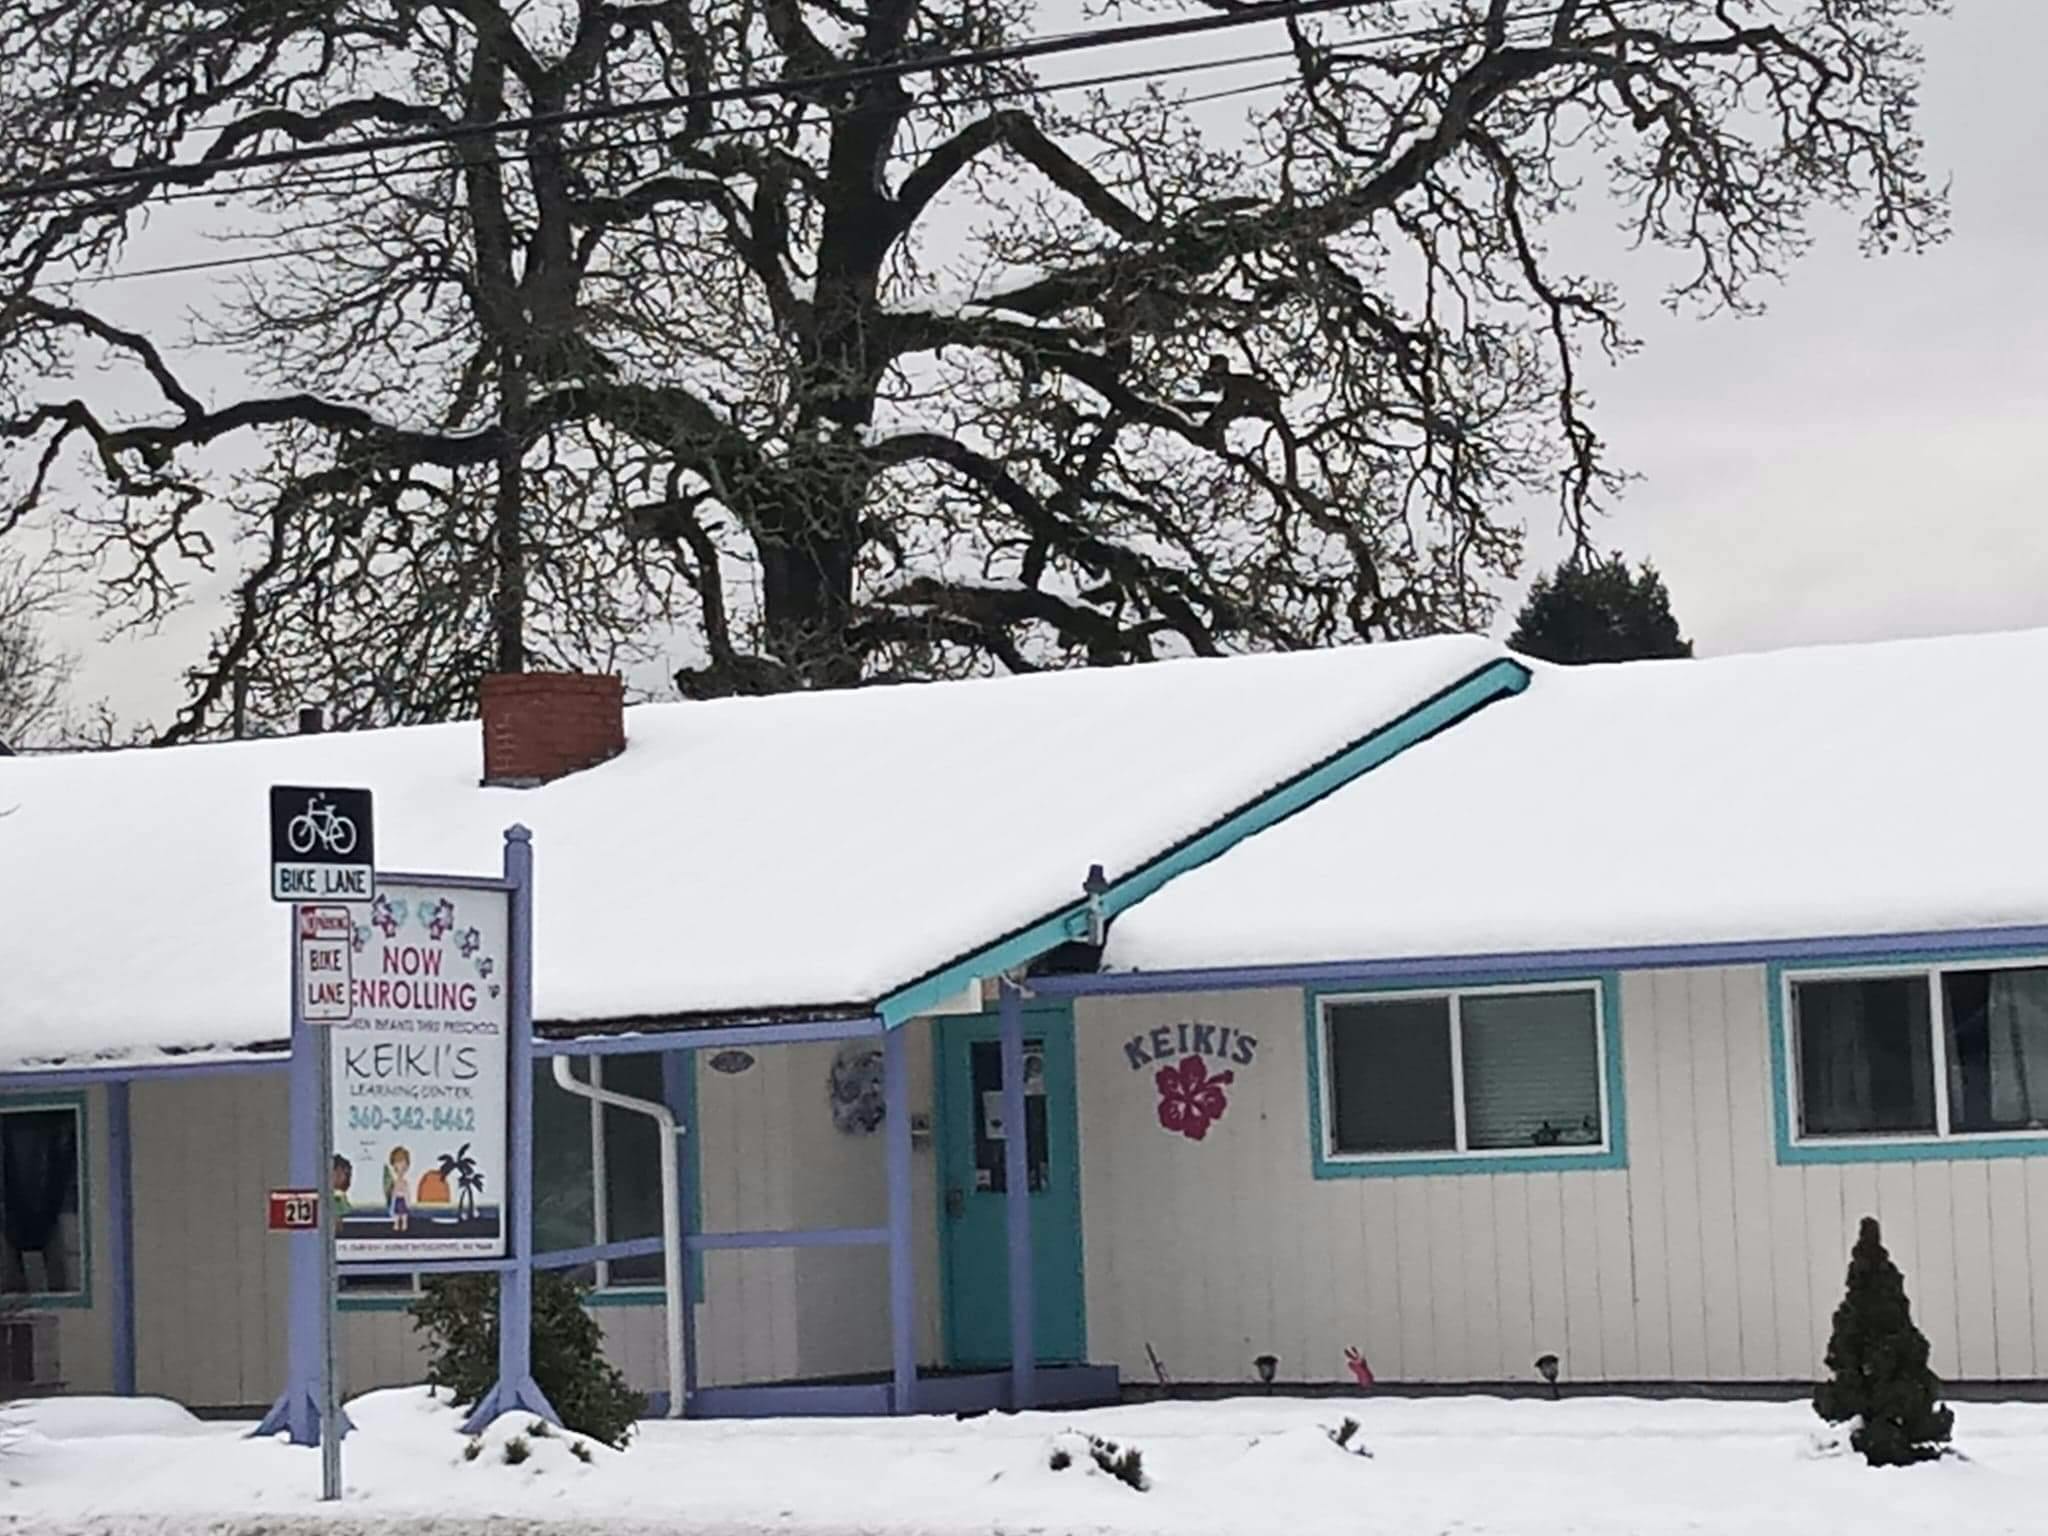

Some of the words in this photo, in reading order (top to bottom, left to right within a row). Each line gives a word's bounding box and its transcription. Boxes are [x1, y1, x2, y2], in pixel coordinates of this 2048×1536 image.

[280, 868, 316, 893] BIKE
[324, 869, 367, 894] LANE
[310, 950, 342, 971] BIKE
[383, 945, 442, 976] NOW
[308, 983, 345, 1005] LANE
[351, 979, 477, 1012] ENROLLING
[1123, 1023, 1258, 1070] KEIKI'S
[345, 1043, 479, 1080] KEIKI'S
[350, 1084, 419, 1100] LEARNING
[421, 1085, 473, 1100] CENTER
[287, 1202, 311, 1222] 213
